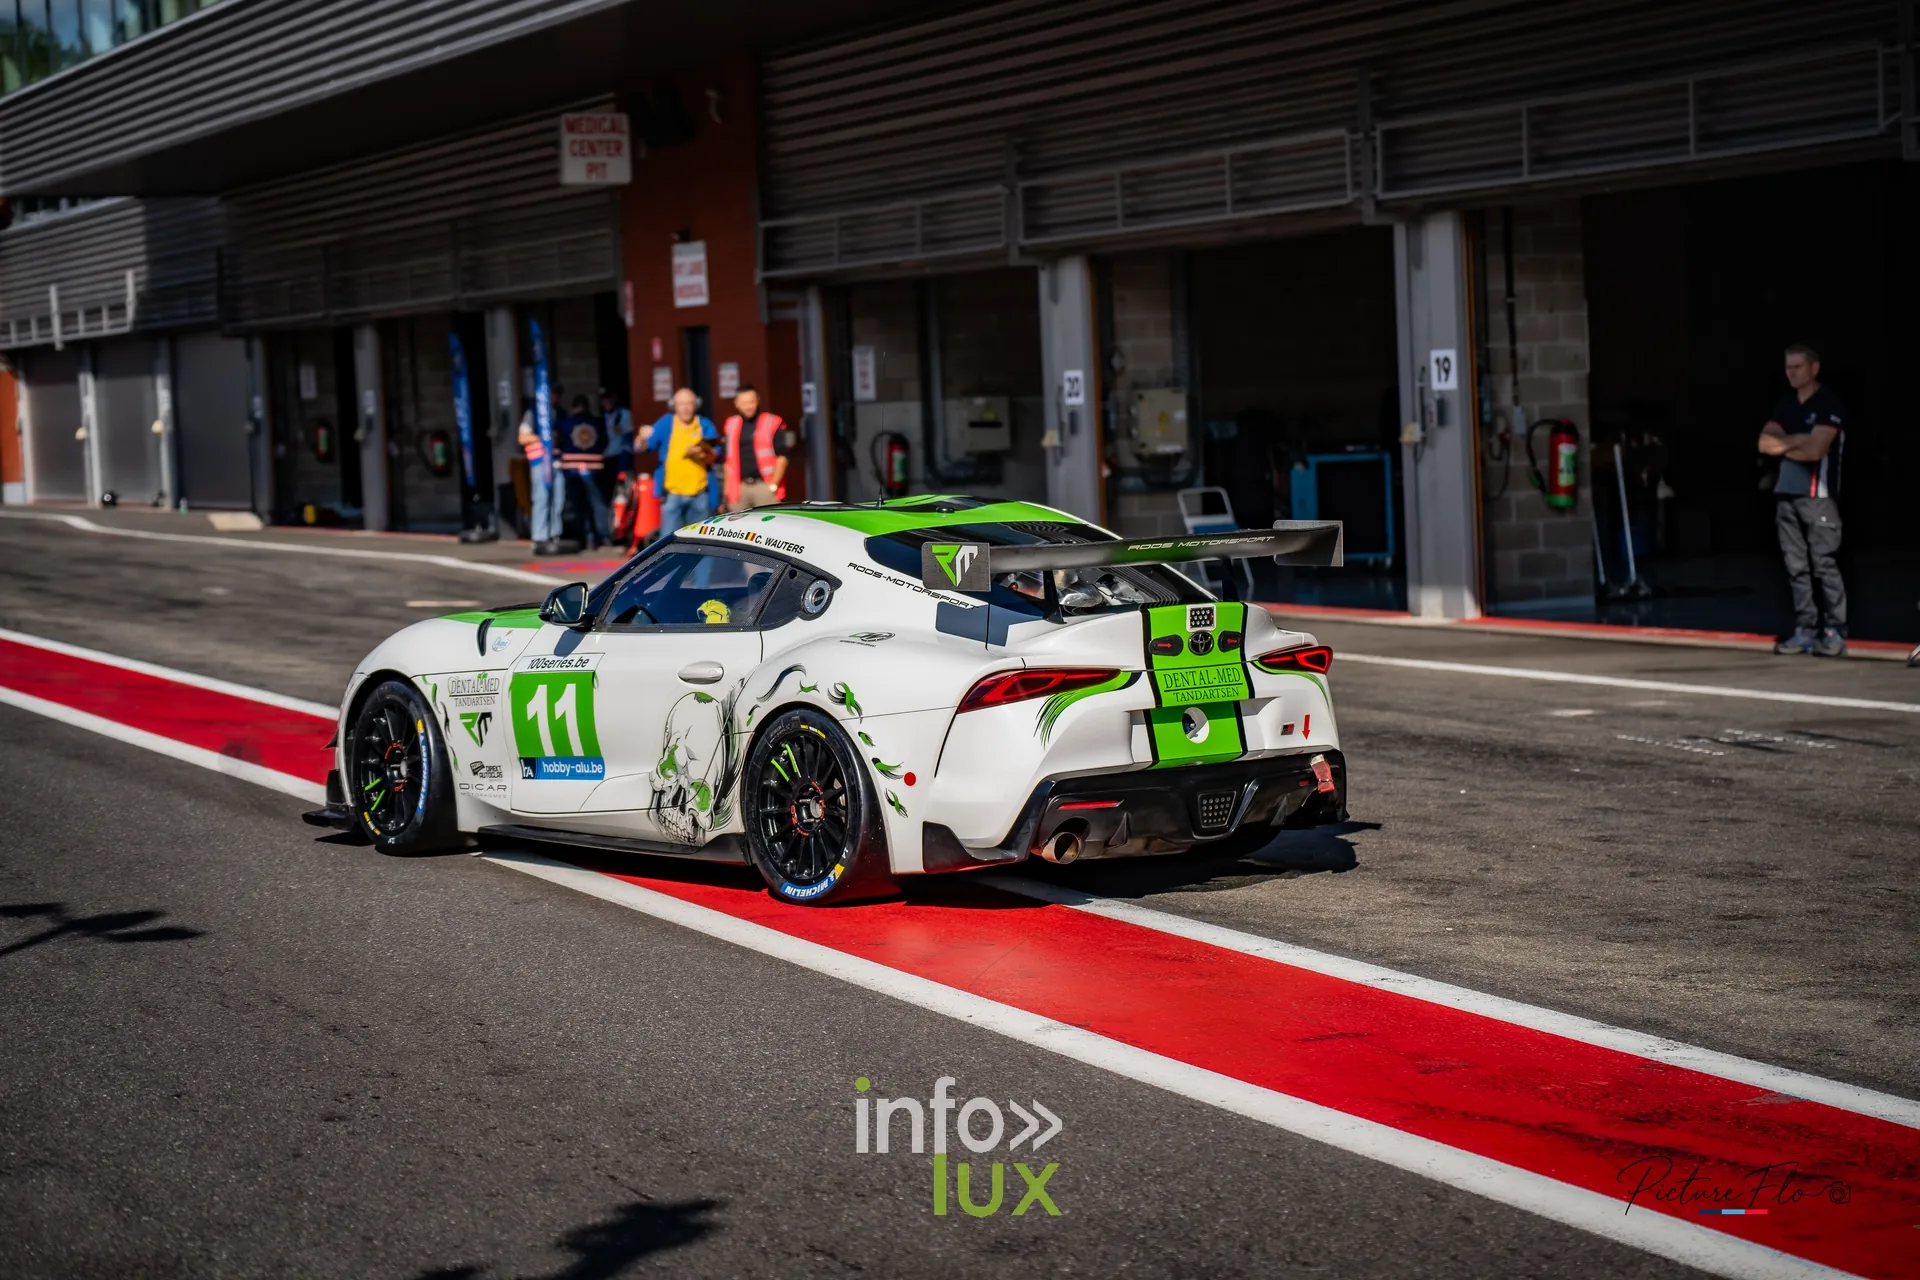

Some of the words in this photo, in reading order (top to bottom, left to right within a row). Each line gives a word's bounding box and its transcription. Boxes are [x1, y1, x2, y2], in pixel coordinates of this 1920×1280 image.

[565, 116, 626, 134] MEDICAL
[569, 139, 624, 158] CENTER
[585, 162, 608, 179] PIT
[1435, 356, 1451, 383] 19
[708, 526, 715, 536] P.
[717, 527, 745, 539] Dubois
[755, 535, 762, 544] C.
[764, 537, 805, 554] WAUTERS
[1128, 542, 1173, 551] ROOS
[1178, 536, 1275, 548] MOTORSPORT
[847, 562, 980, 610] ROOS-MOTORSPORT
[527, 656, 590, 670] 100series.be
[451, 677, 500, 694] DENTAL-MED
[1163, 667, 1241, 688] DENTAL-MED
[454, 695, 496, 707] TANDARTSEN
[1173, 687, 1239, 702] TANDARTSEN
[526, 683, 584, 756] 11
[543, 760, 603, 776] hobby-alu.be
[459, 783, 507, 792] DICAR
[785, 878, 829, 897] MICHELIN
